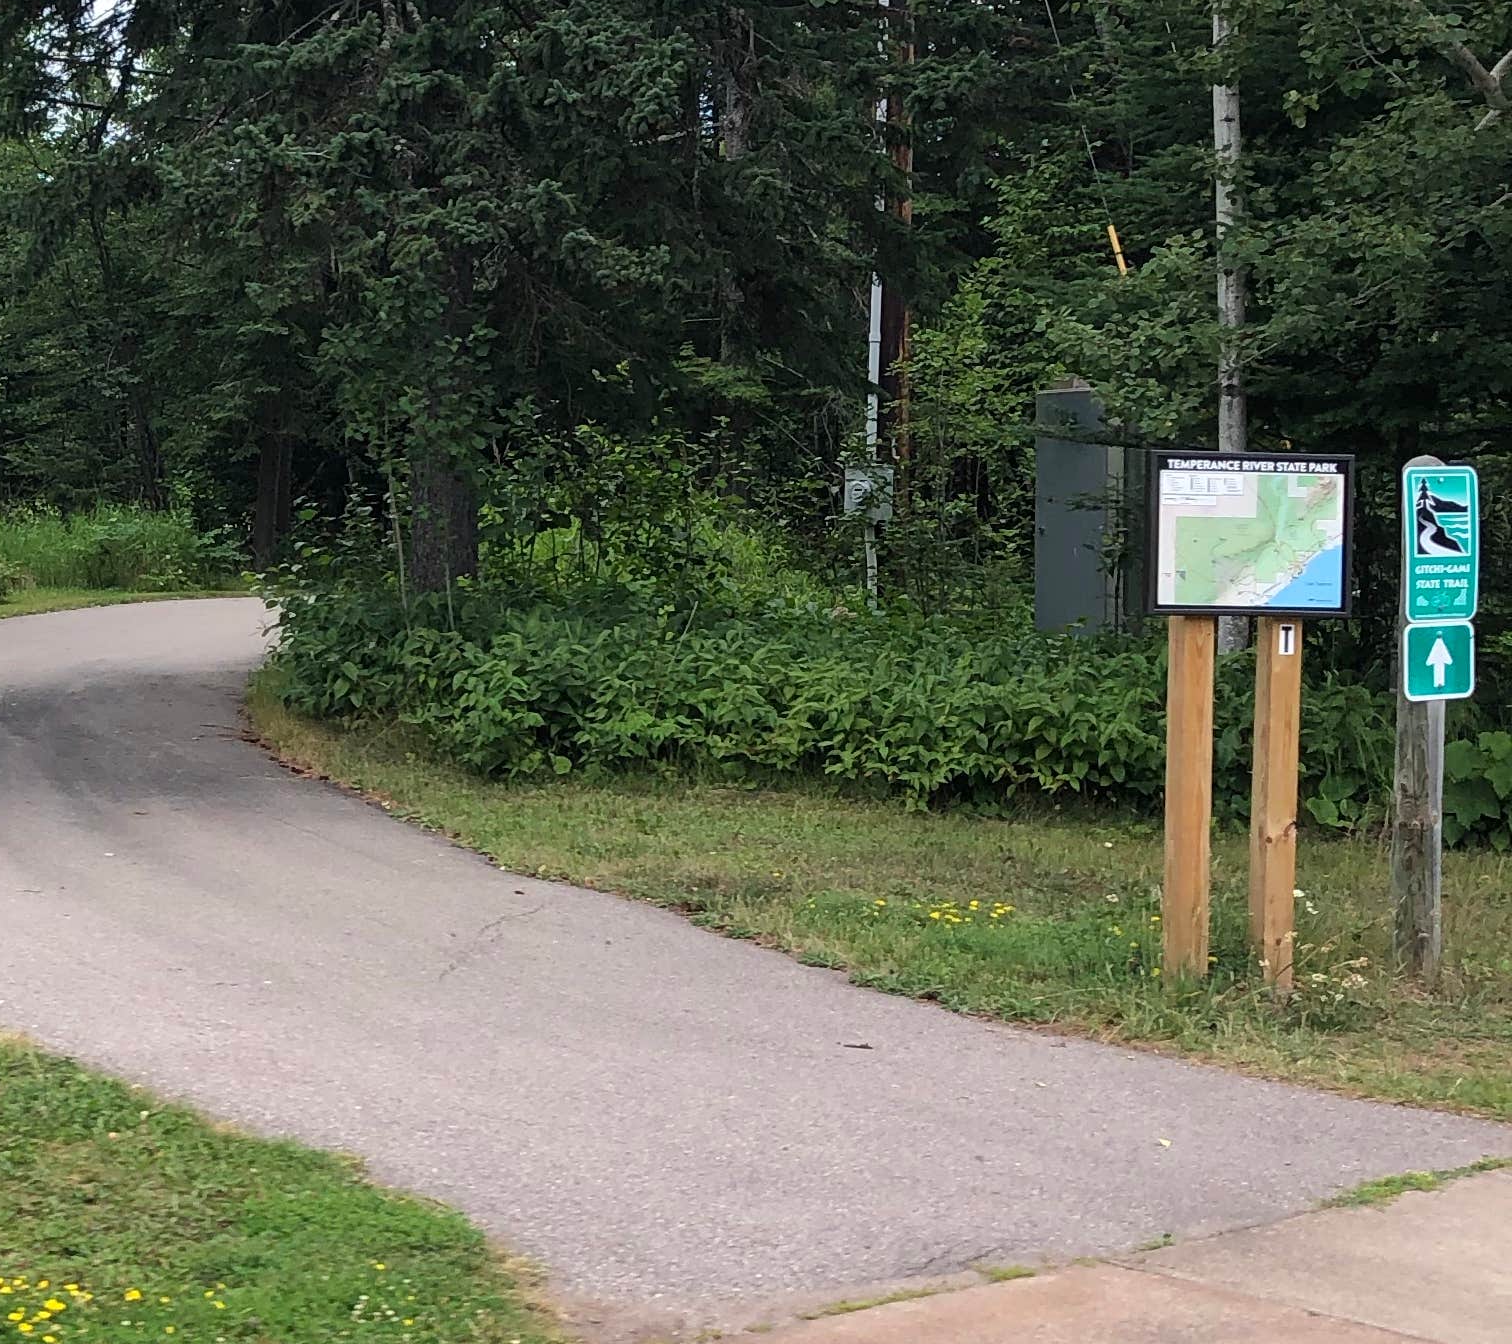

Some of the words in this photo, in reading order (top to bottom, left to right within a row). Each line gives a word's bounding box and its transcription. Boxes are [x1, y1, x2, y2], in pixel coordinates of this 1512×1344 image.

[1167, 459, 1240, 471] TEMPERANCE
[1242, 460, 1274, 471] RIVER
[1276, 461, 1307, 472] STATE
[1308, 462, 1338, 473] PARK
[1416, 579, 1440, 589] STATE
[1443, 579, 1469, 588] TRAIL
